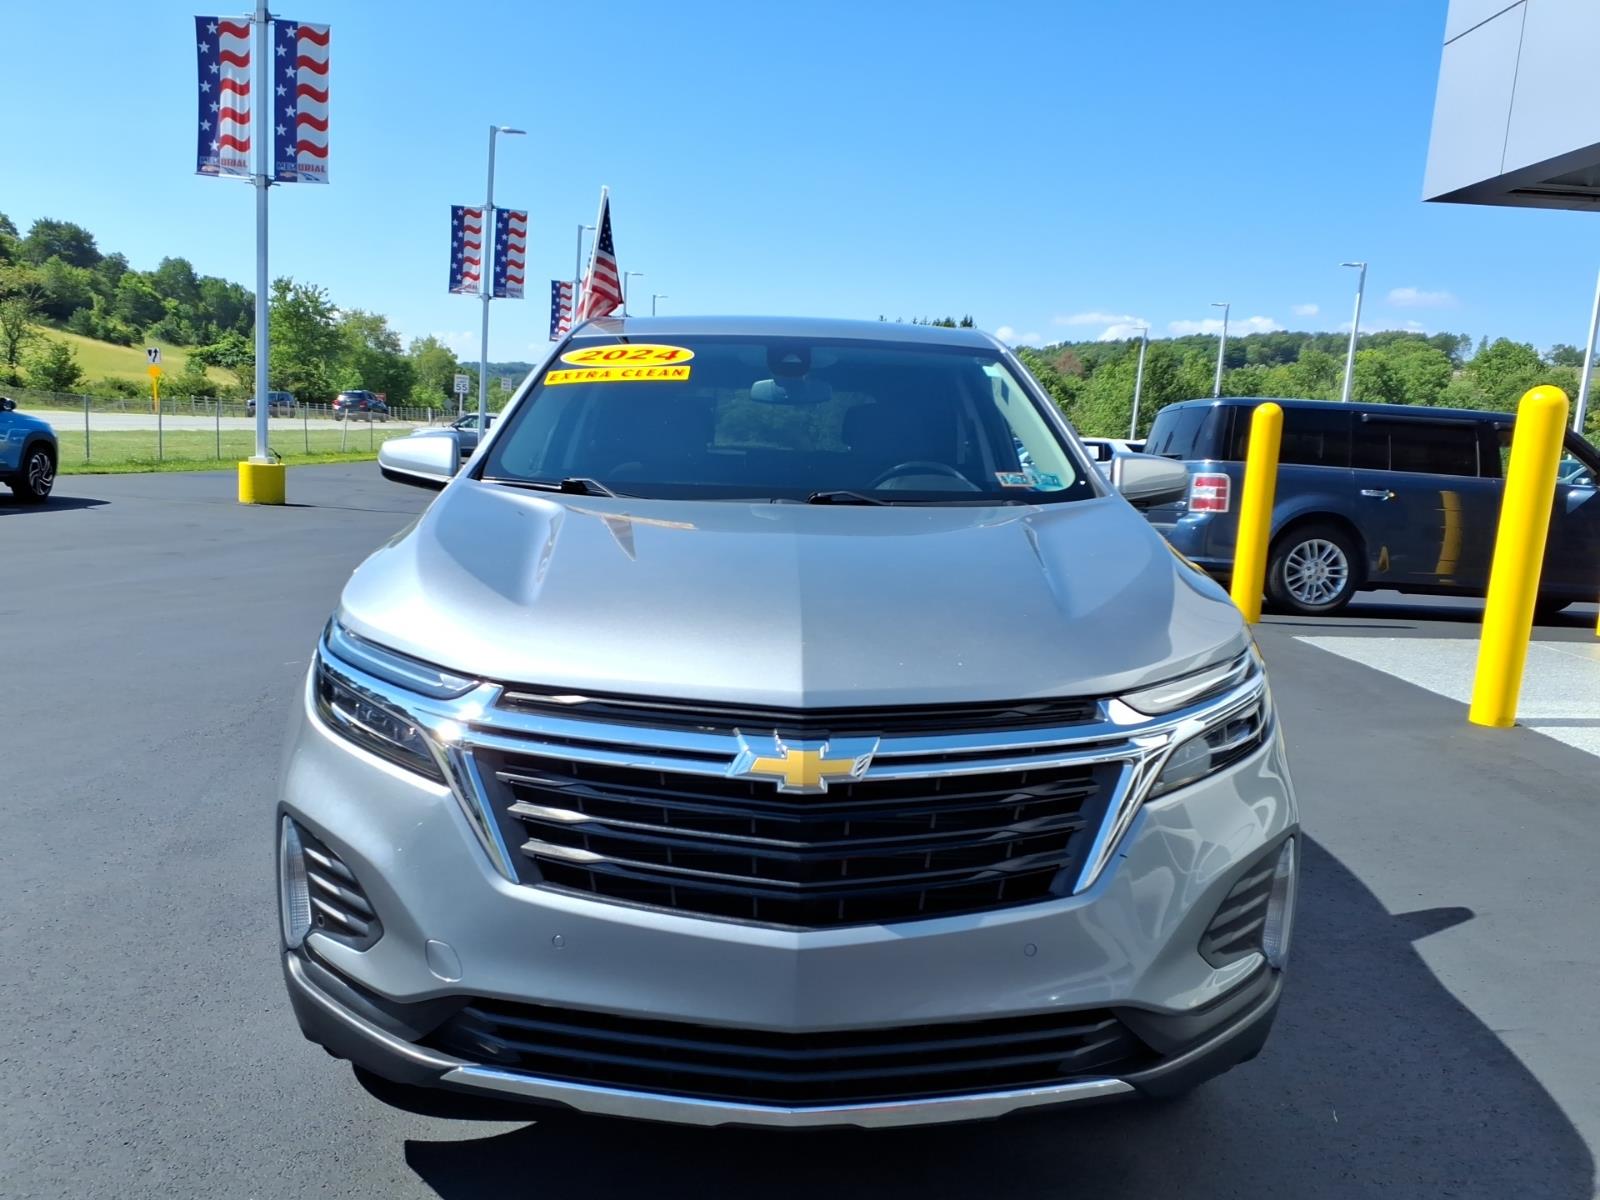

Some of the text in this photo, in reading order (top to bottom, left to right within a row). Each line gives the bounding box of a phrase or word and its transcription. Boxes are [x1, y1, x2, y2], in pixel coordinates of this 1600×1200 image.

[575, 349, 681, 362] 2024
[548, 368, 686, 382] EXTRA CLEAN
[455, 383, 468, 391] 55
